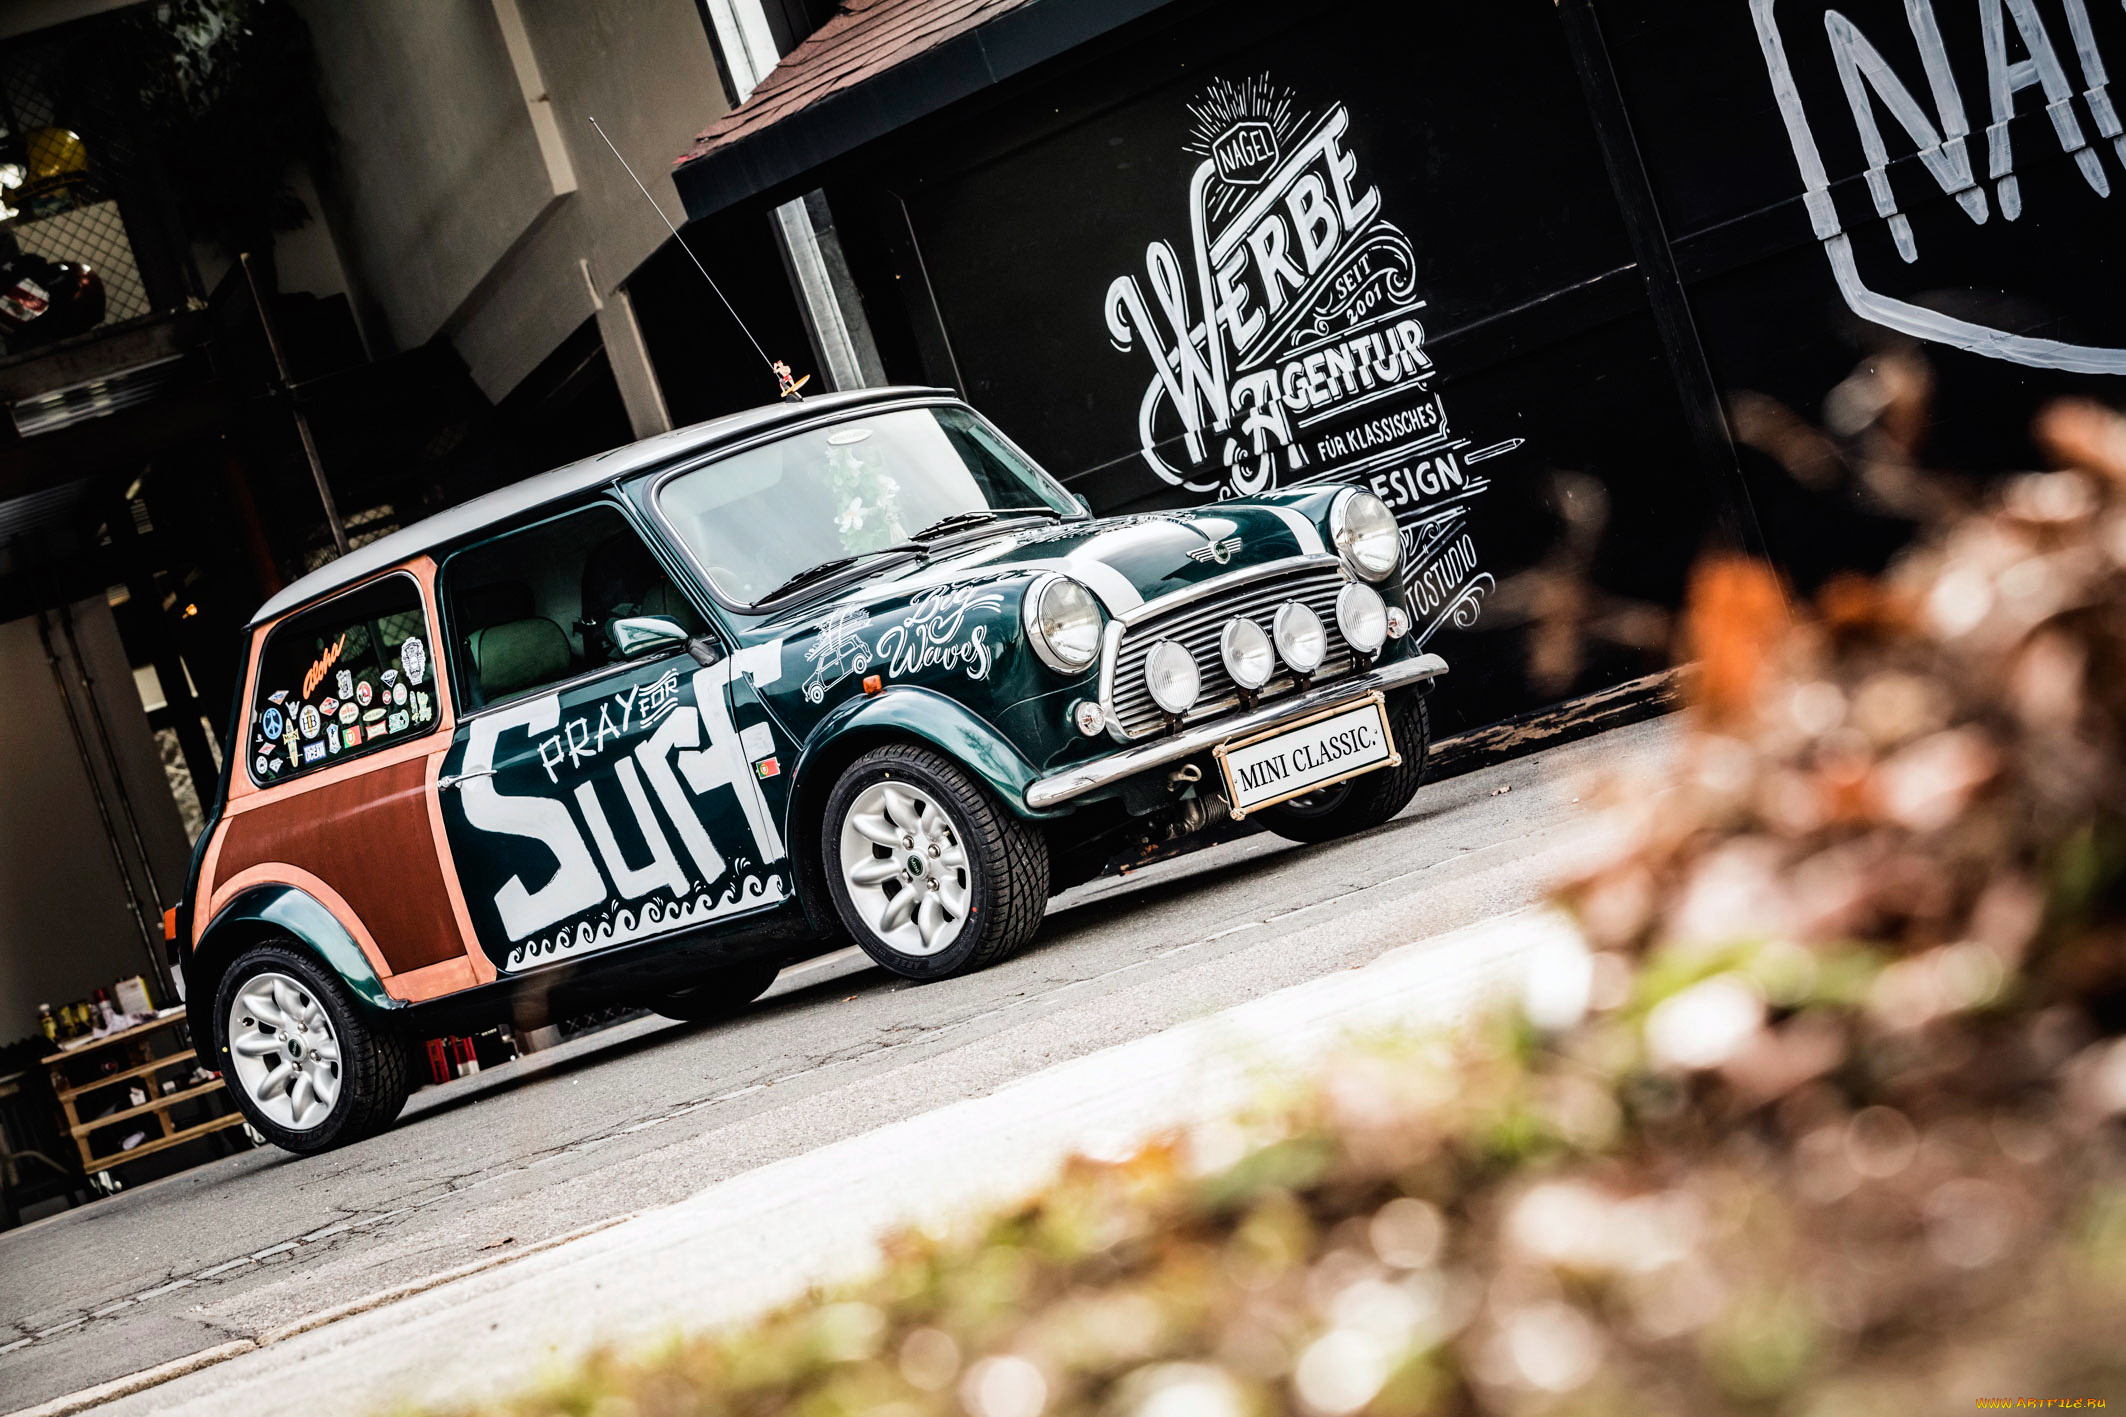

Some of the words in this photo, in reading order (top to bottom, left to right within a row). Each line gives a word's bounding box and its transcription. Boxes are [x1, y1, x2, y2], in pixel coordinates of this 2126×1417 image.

[1219, 128, 1275, 174] NAGEL
[1335, 253, 1371, 300] SEIT
[1346, 282, 1382, 326] 2001
[1228, 318, 1433, 495] AGENTUR
[1345, 402, 1438, 452] KLASSISCHES
[1369, 452, 1463, 509] ESIGN
[1405, 533, 1478, 631] TOSTUDIO
[903, 584, 1005, 645] Big
[876, 624, 992, 681] Waves
[537, 683, 640, 785] PRAY
[638, 676, 680, 718] FOR
[1237, 754, 1291, 793] MINI
[1291, 725, 1377, 773] CLASSIC.
